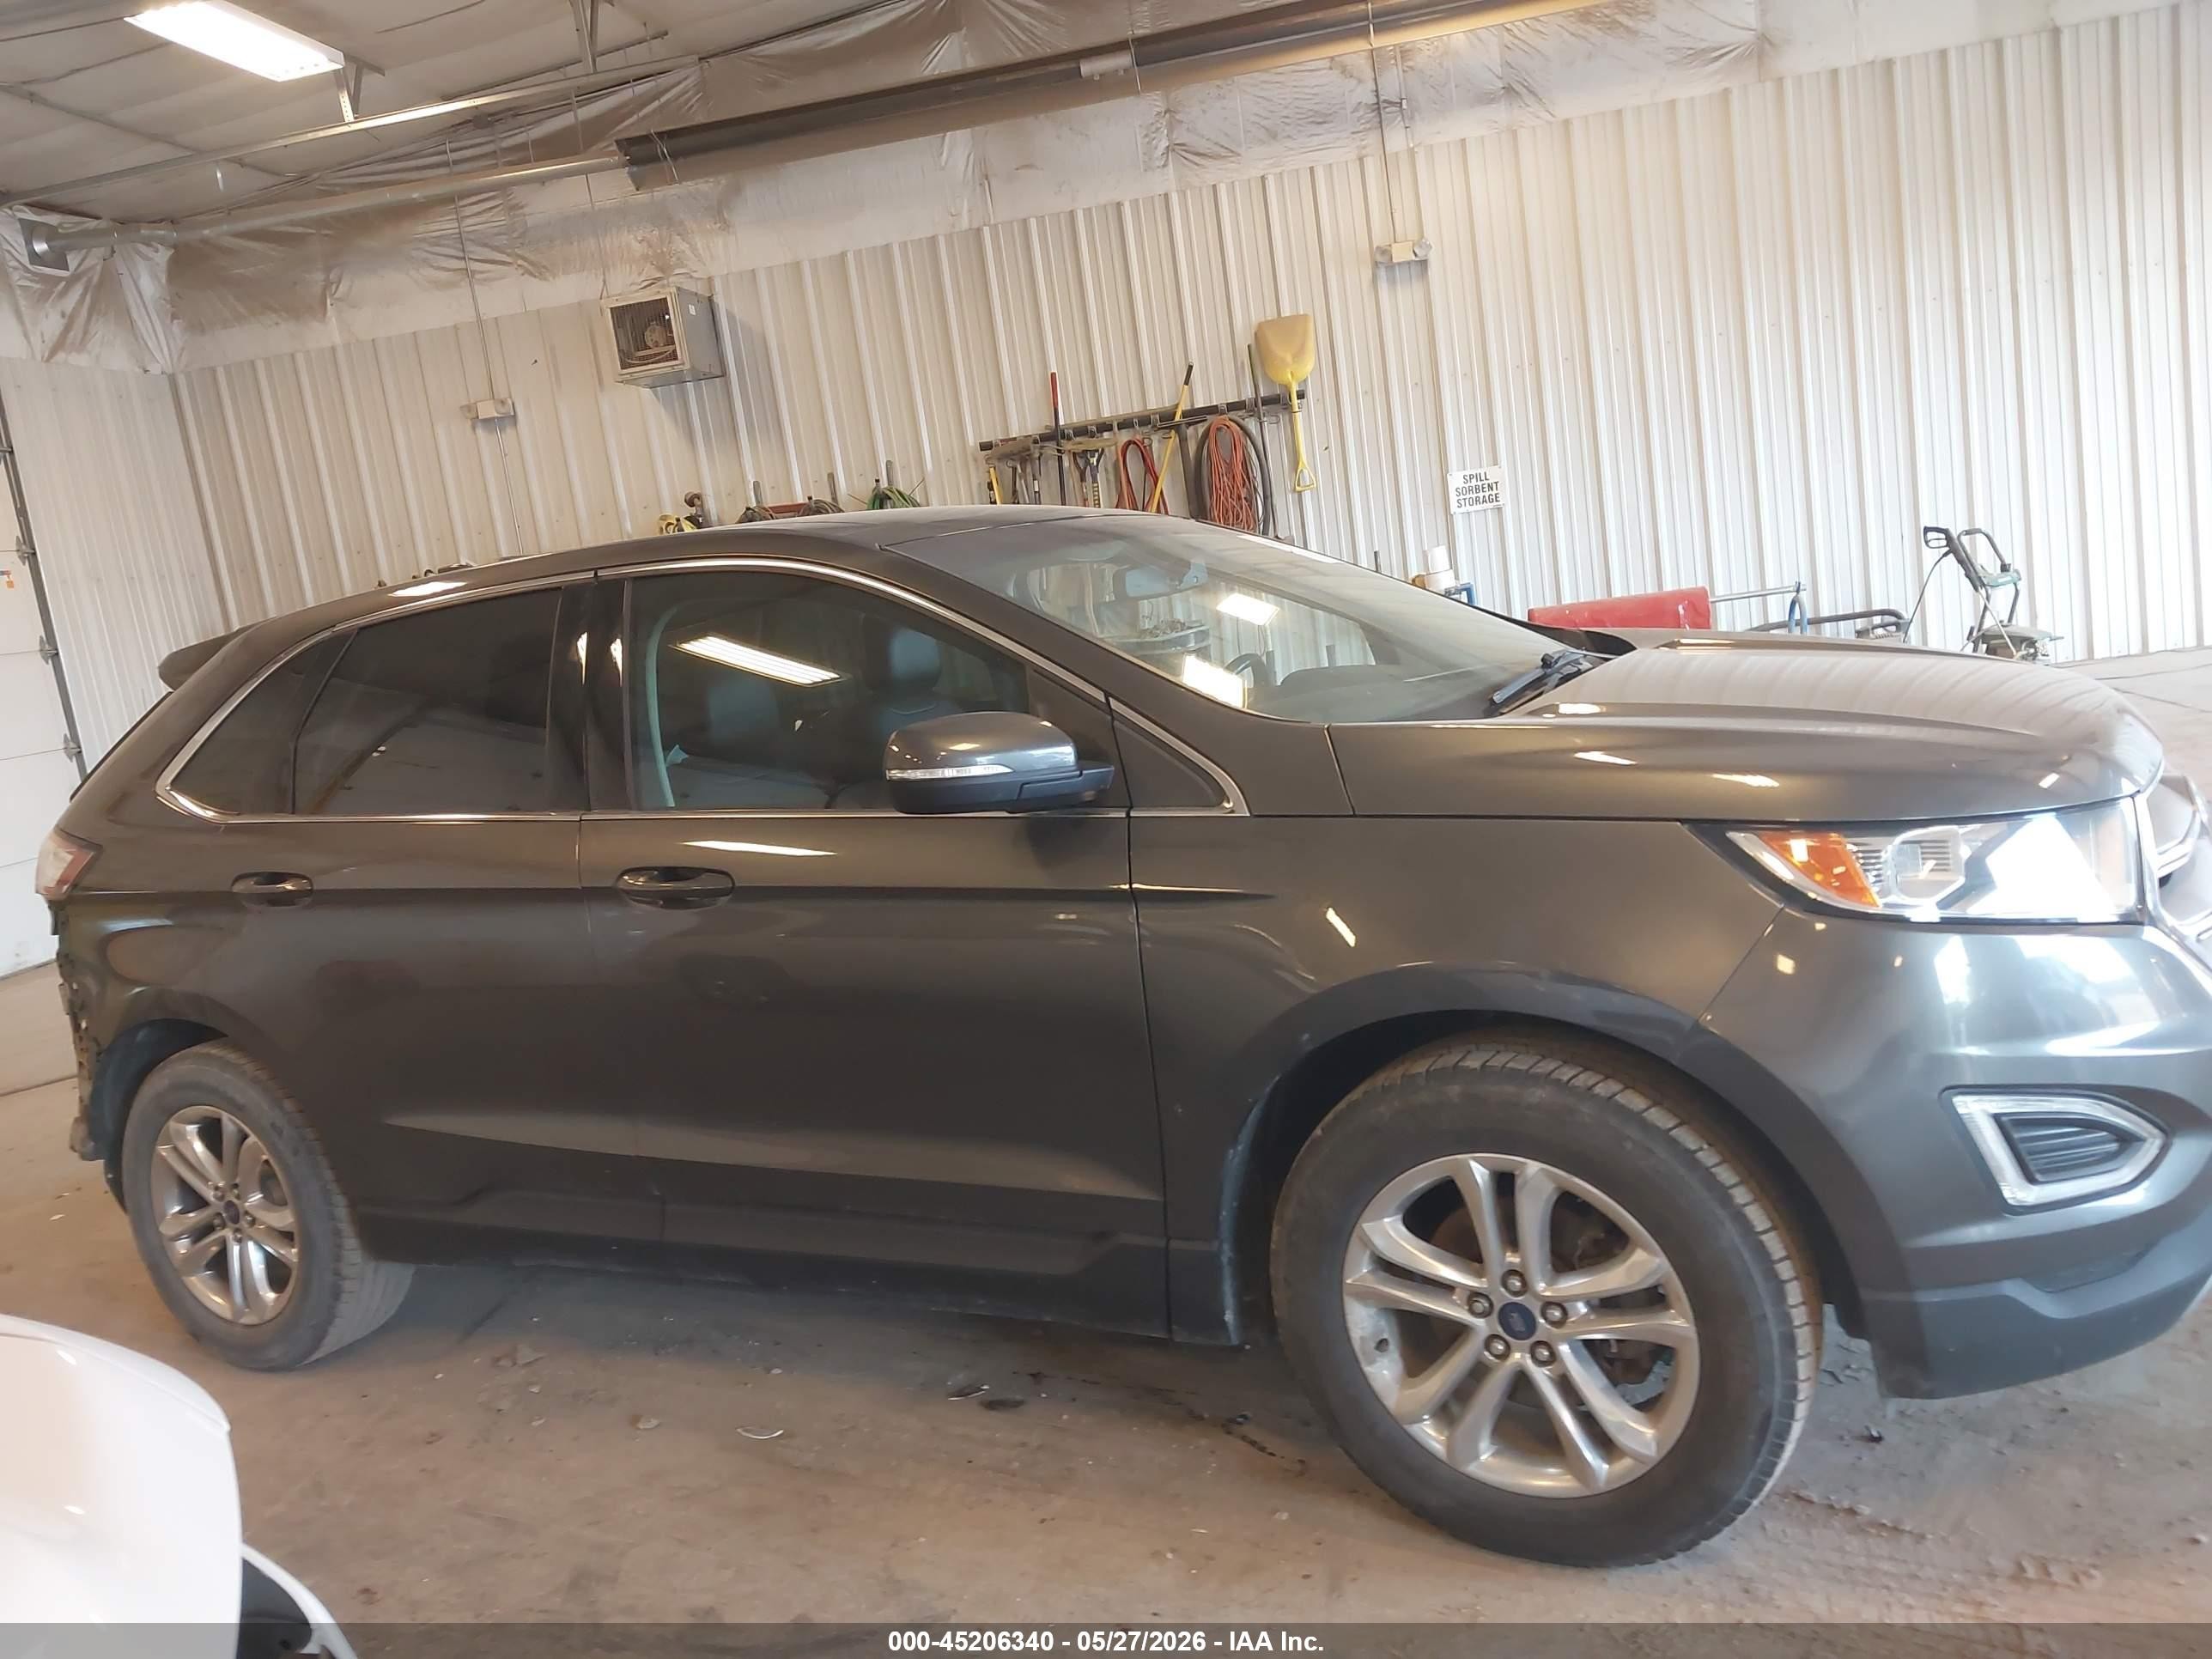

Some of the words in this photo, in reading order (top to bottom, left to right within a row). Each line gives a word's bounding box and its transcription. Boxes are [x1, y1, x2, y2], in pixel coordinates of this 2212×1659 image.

[1462, 471, 1490, 484] SPILL
[1455, 481, 1499, 497] SORBENT
[1456, 493, 1501, 508] STORAGE
